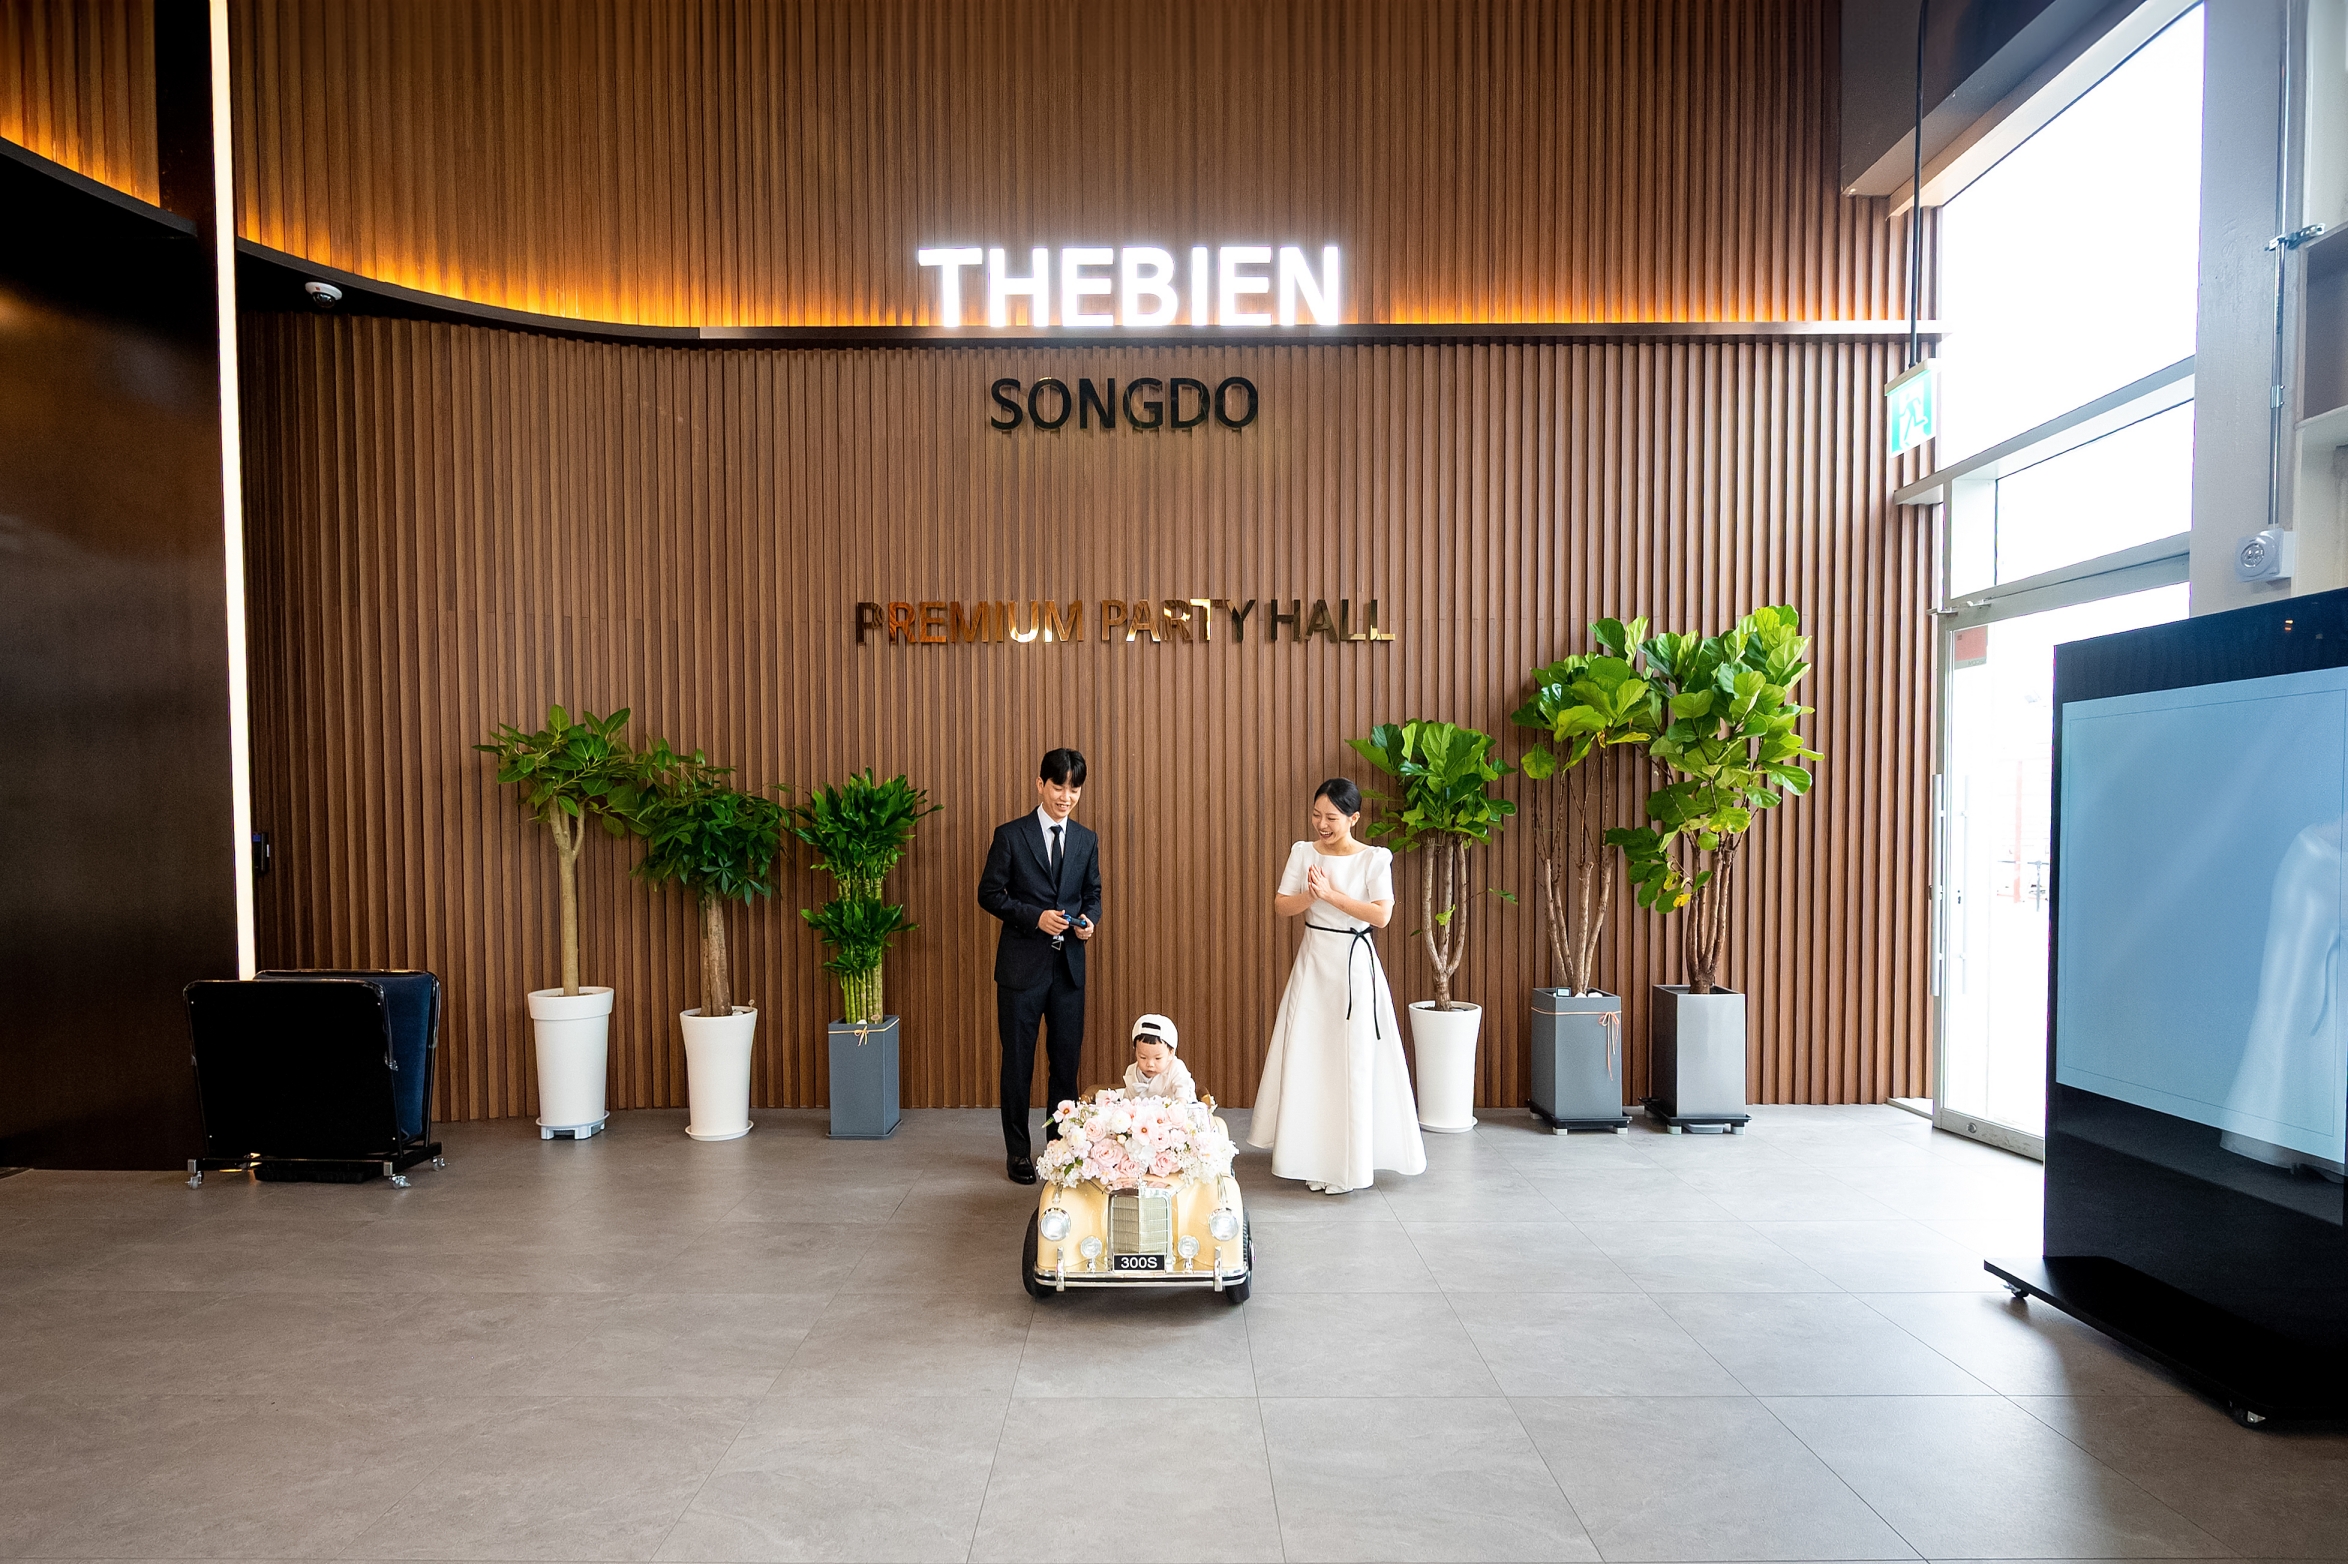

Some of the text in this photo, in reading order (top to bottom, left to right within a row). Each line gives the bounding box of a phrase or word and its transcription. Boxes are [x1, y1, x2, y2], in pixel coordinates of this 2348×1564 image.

[918, 246, 1339, 327] THEBIEN
[990, 377, 1259, 430] SONGDO
[856, 599, 1396, 644] PREMIUM PARTY HALL
[1120, 1256, 1158, 1269] 300S
